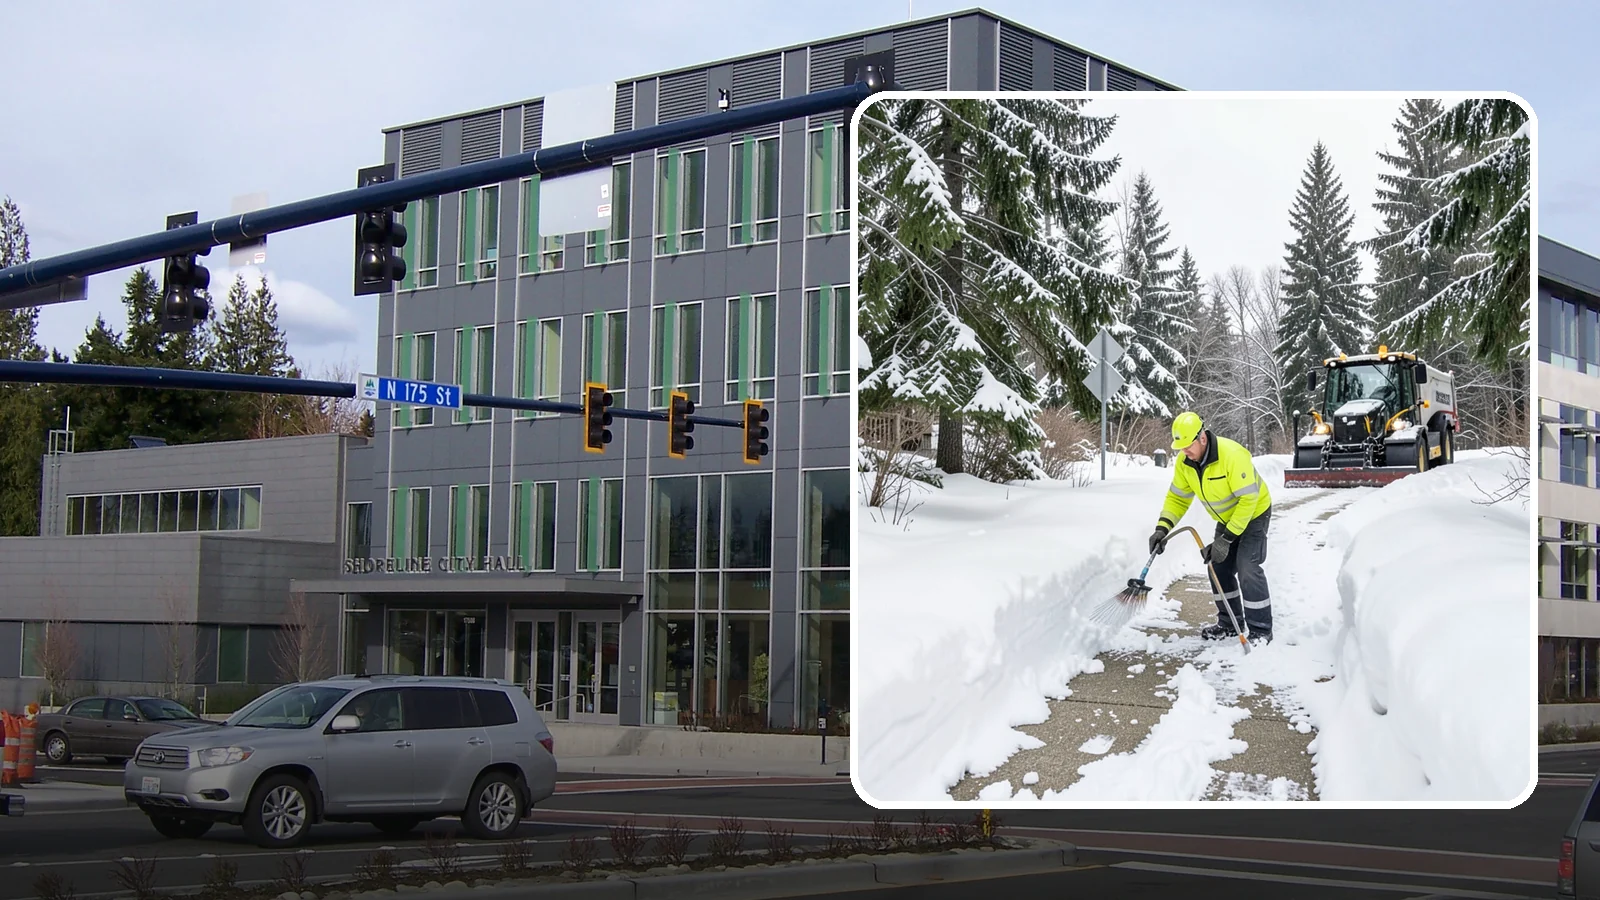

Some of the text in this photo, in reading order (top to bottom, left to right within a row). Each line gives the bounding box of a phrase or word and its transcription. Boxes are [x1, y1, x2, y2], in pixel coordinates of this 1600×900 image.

[387, 380, 451, 406] N 175 St
[343, 555, 525, 574] SHORELINE CITY HALL
